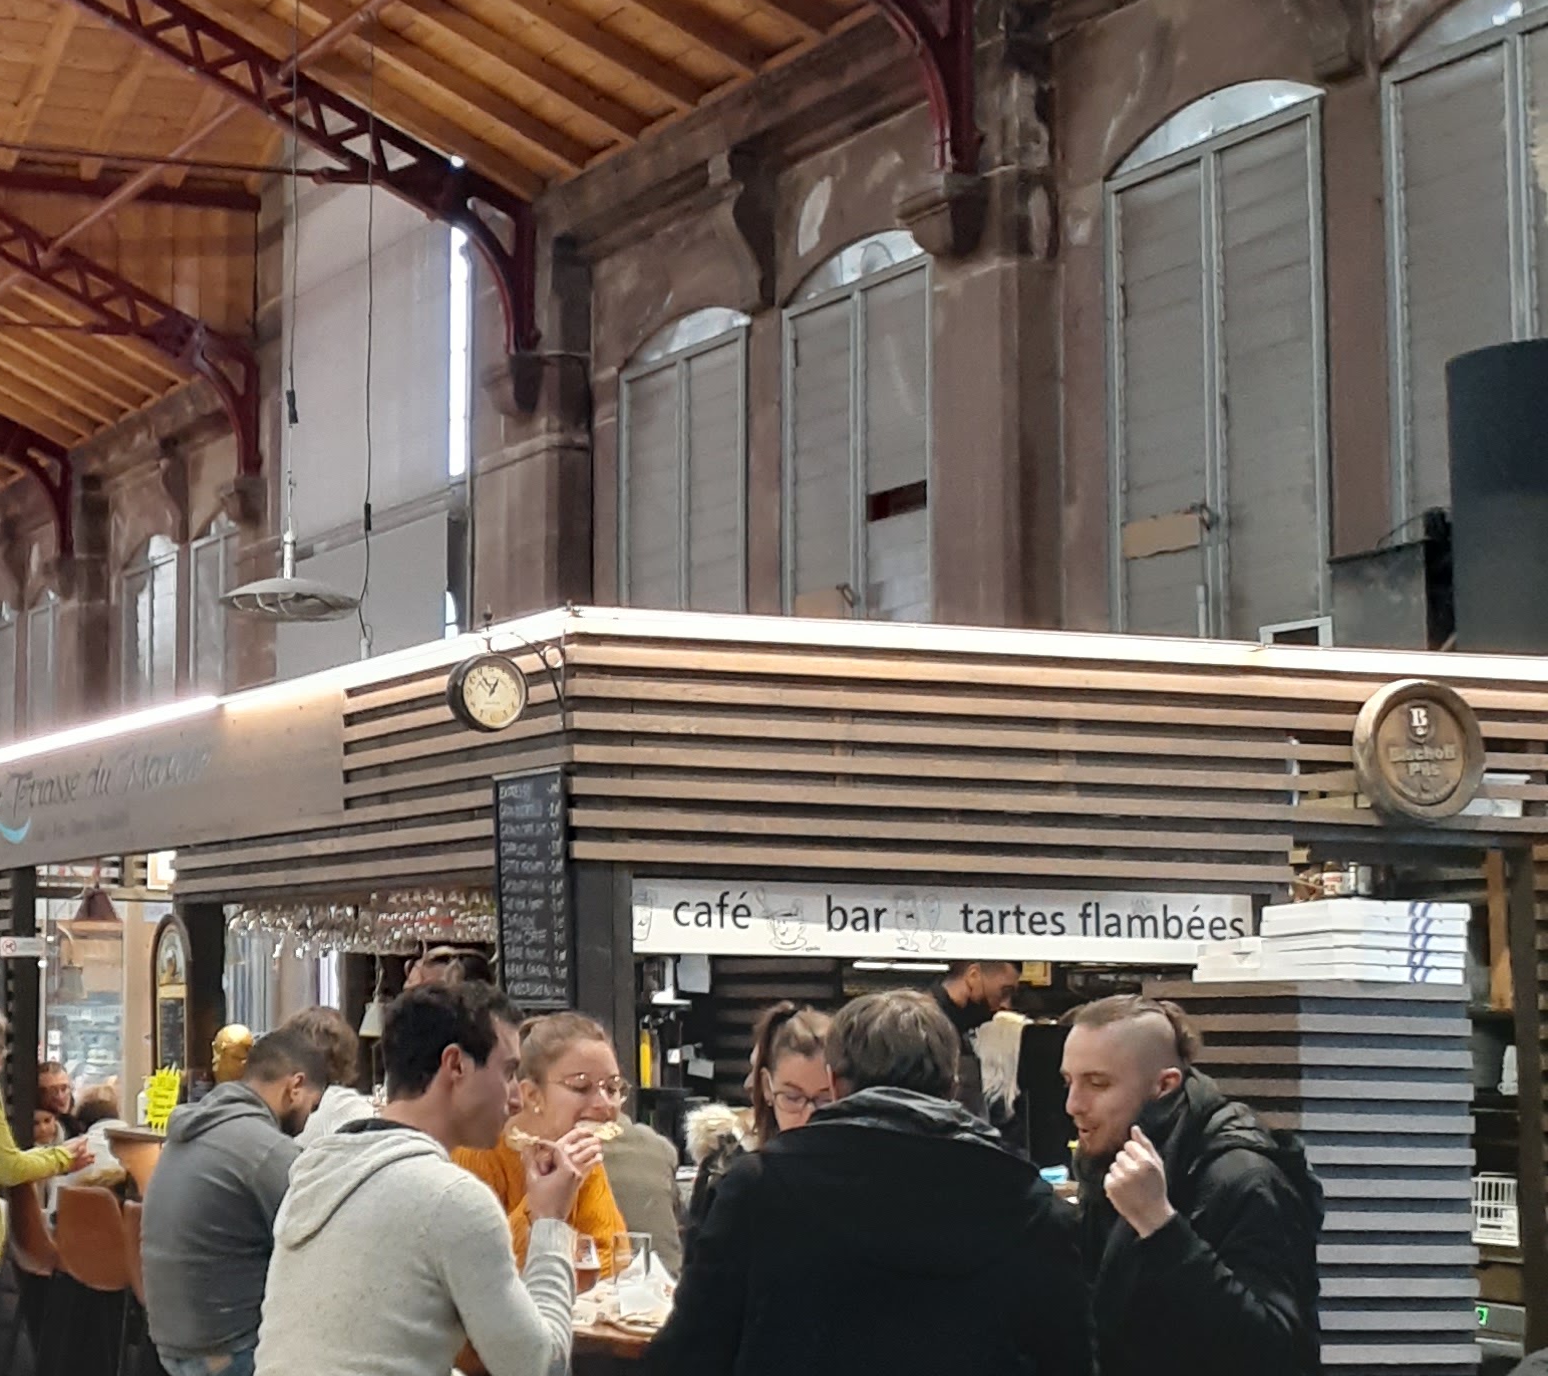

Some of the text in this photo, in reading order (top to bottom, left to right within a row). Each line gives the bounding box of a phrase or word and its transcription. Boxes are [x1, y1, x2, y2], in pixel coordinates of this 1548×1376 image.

[1410, 708, 1428, 726] B
[673, 891, 888, 934] café bar
[959, 900, 1246, 942] tartes flambées
